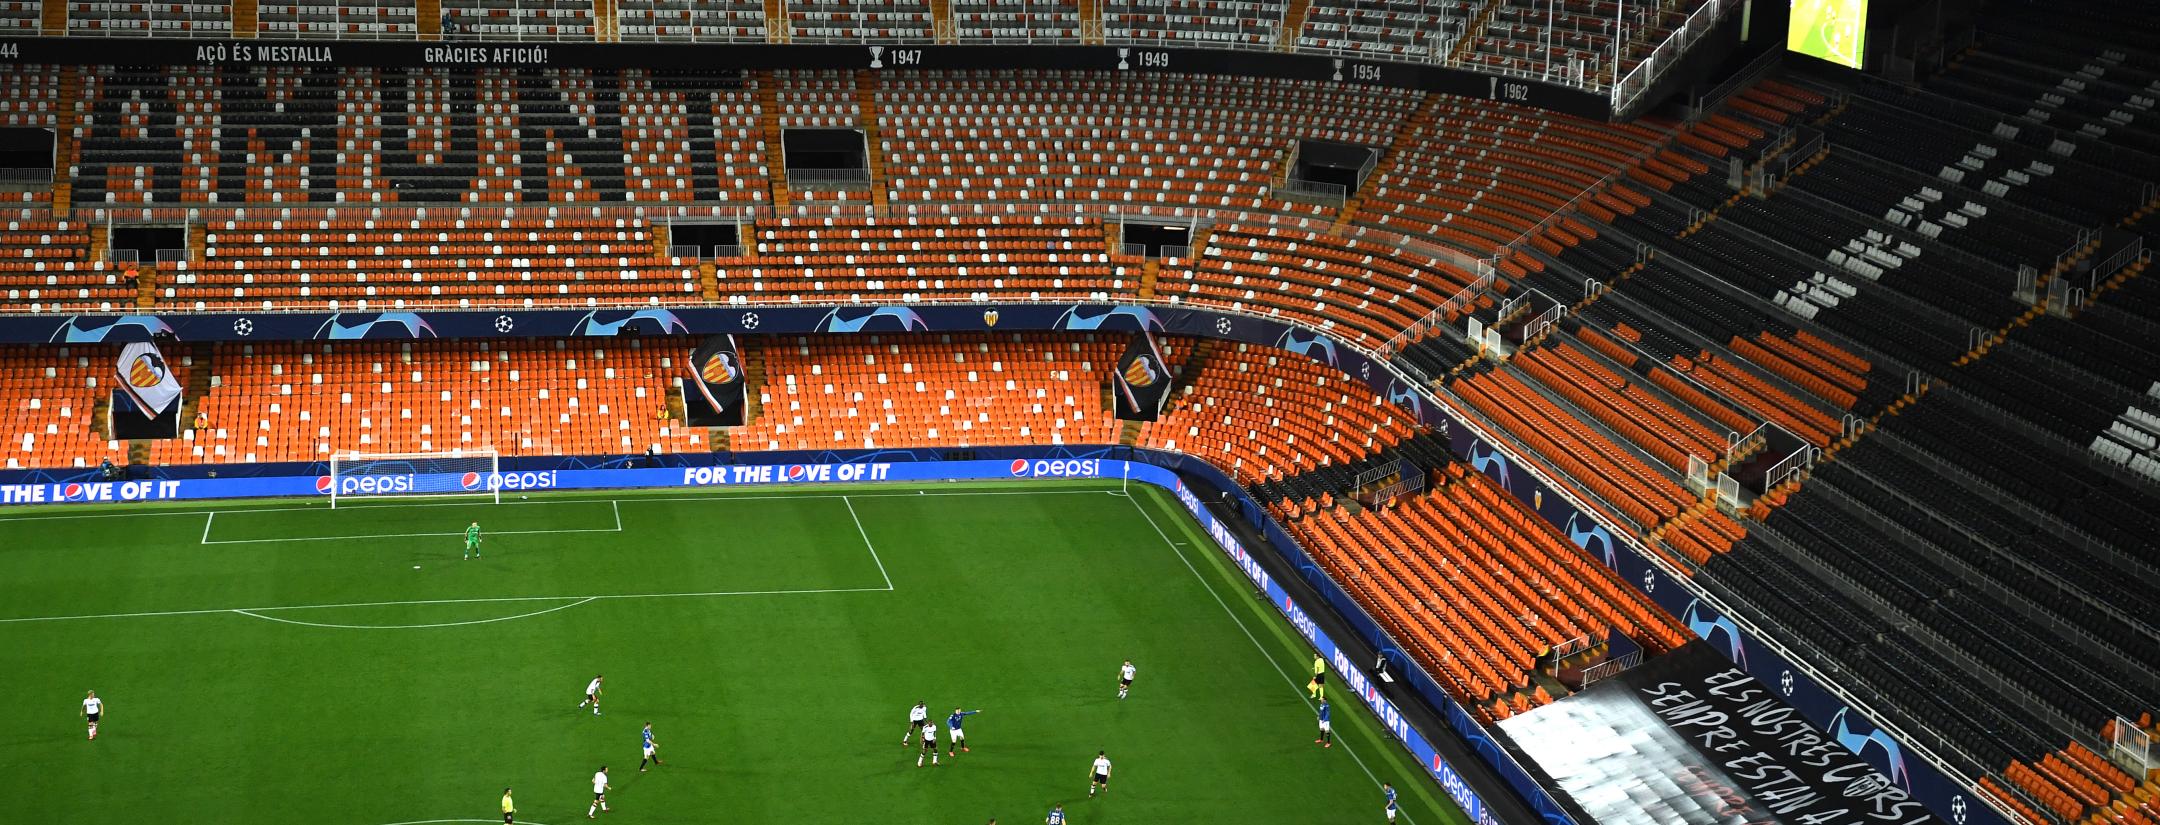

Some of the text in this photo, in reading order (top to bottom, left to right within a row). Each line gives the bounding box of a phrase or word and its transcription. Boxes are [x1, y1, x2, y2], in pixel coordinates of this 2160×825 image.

[197, 43, 333, 64] AÇÒ ÉS MESTALLA
[425, 47, 549, 63] GRÀCIES AFICIÓ!
[891, 50, 922, 65] 1947
[1138, 51, 1169, 67] 1949
[1352, 64, 1382, 81] 1954
[1503, 82, 1529, 101] 1962
[684, 467, 727, 485] FOR
[733, 465, 772, 483] THE
[837, 463, 866, 481] OF
[870, 463, 891, 480] IT
[1034, 458, 1100, 477] pepsi
[342, 473, 414, 494] pepsi
[487, 469, 557, 490] pepsi
[1, 484, 45, 503] THE
[120, 482, 153, 499] OF
[158, 480, 181, 498] IT
[1181, 485, 1199, 514] pepsi
[1211, 516, 1225, 541] FOR
[1225, 530, 1236, 555] THE
[1252, 562, 1262, 584] OF
[1293, 606, 1316, 642] pepsi
[1334, 647, 1348, 679] FOR
[1349, 668, 1365, 697] THE
[1386, 706, 1399, 732] OF
[1400, 719, 1409, 742] IT
[1704, 668, 1763, 702] ELS
[1736, 699, 1848, 767] NOSTRES
[1641, 681, 1752, 753] SEMPRE
[1725, 751, 1827, 814] ESTAN
[1443, 767, 1473, 813] pepsi
